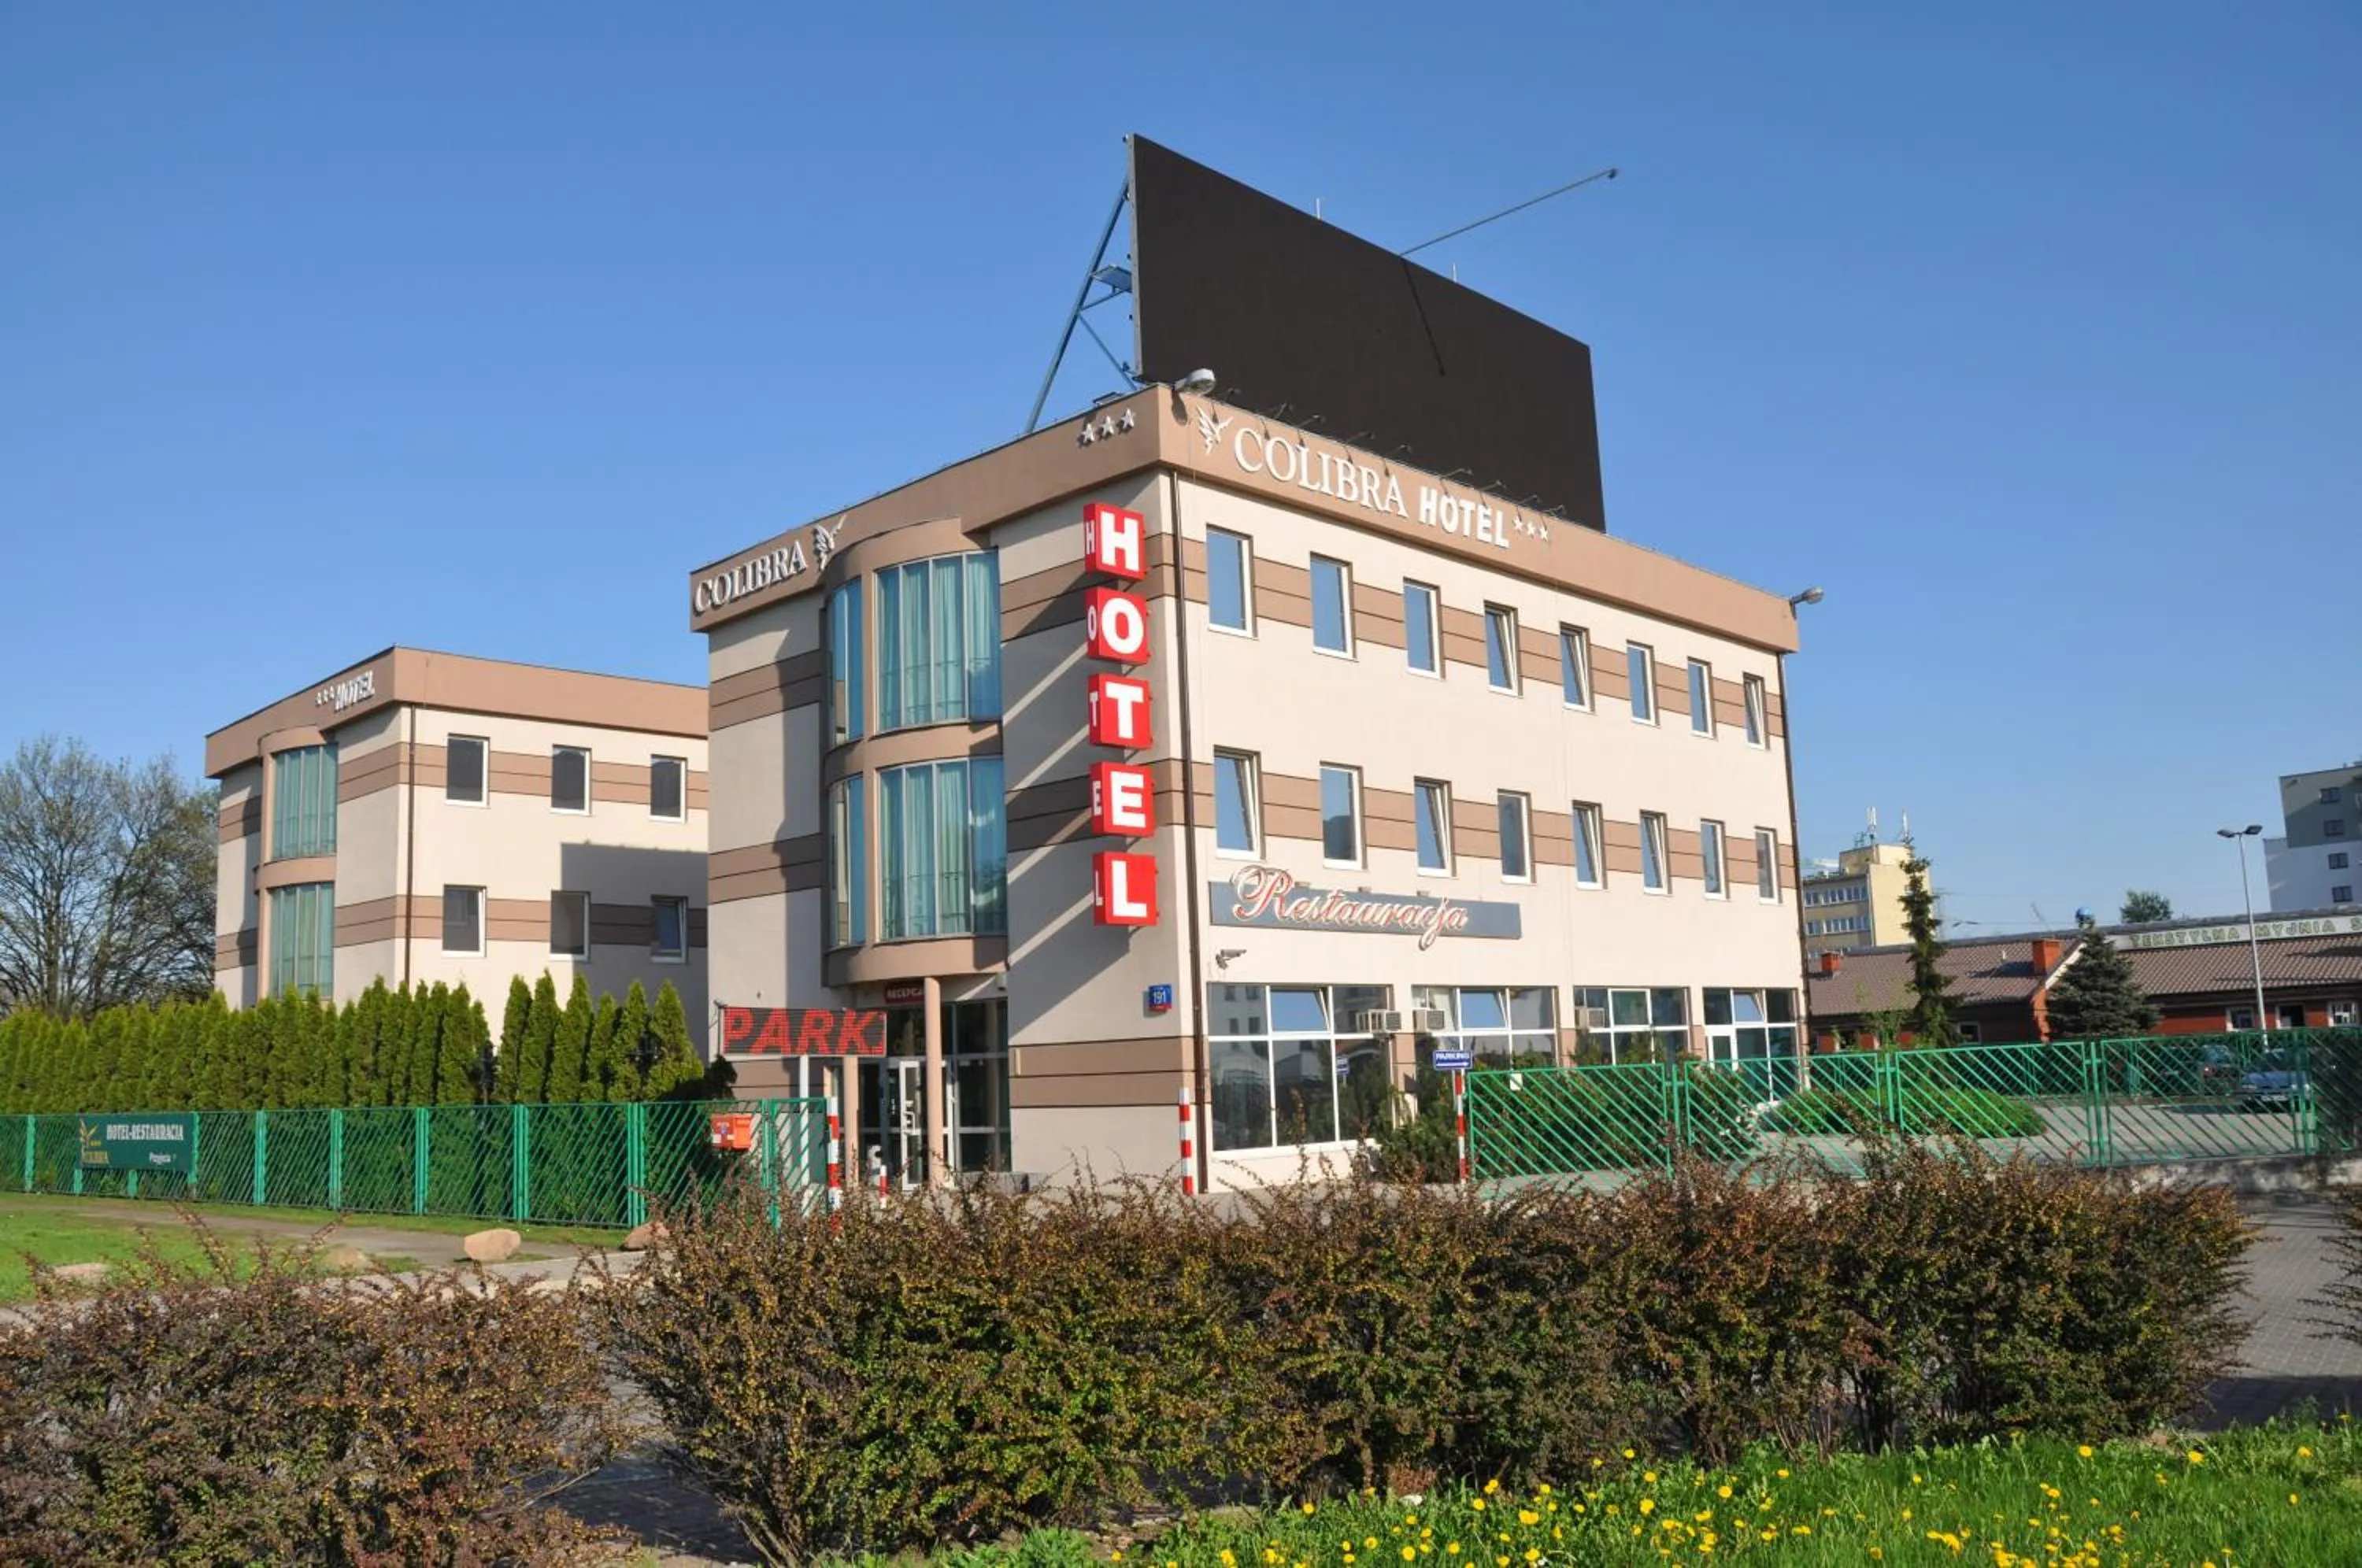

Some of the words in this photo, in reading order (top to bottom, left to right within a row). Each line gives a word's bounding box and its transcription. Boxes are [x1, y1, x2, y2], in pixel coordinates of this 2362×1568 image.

[1234, 427, 1409, 519] COLIBRA
[1419, 485, 1510, 549] HOTEL
[694, 539, 809, 613] COLIBRA
[1085, 520, 1103, 907] HOTEL
[1101, 510, 1148, 918] HOTEL
[1230, 865, 1470, 951] Restauracja
[2255, 919, 2337, 937] MYJNIA
[2350, 916, 2362, 931] S
[106, 1123, 185, 1141] HOTEL-RESTAURACJA
